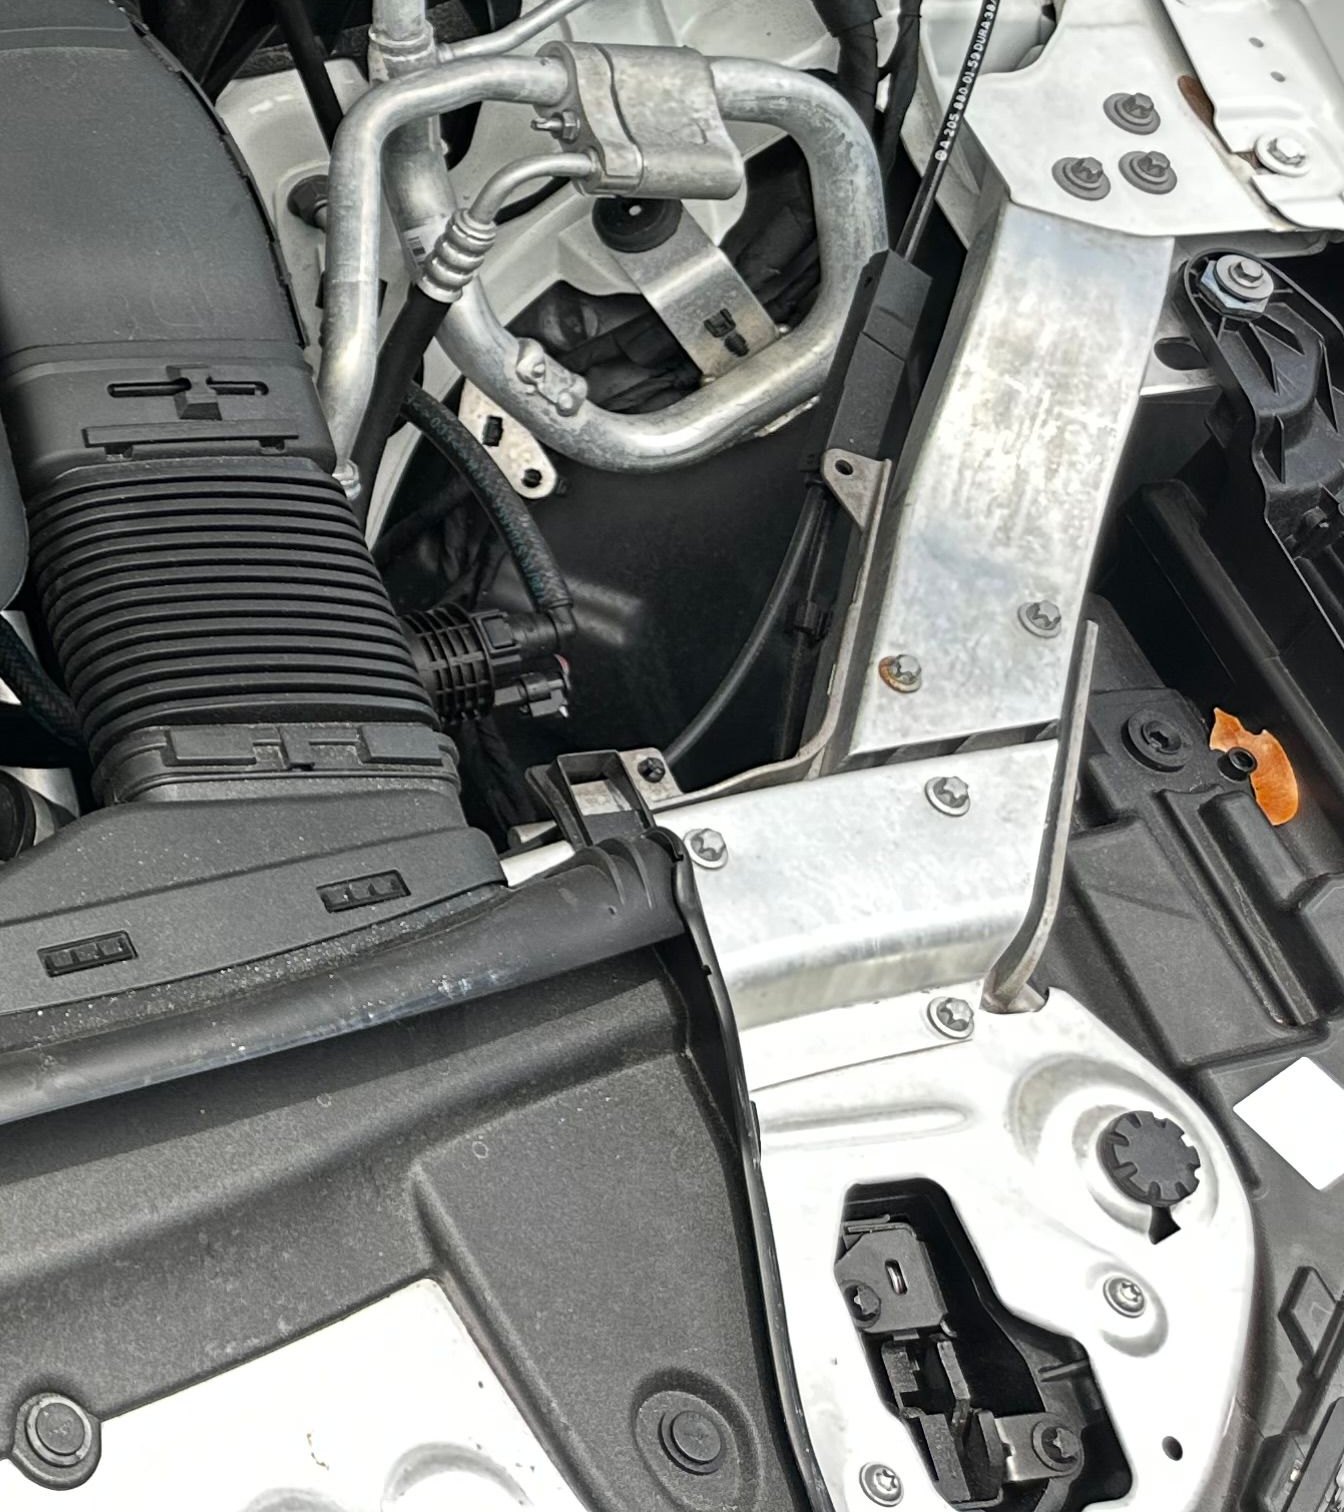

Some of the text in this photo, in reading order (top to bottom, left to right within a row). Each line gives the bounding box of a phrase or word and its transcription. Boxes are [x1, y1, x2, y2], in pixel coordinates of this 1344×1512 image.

[943, 113, 960, 137] 205
[962, 71, 975, 84] 01
[973, 21, 991, 52] DURA
